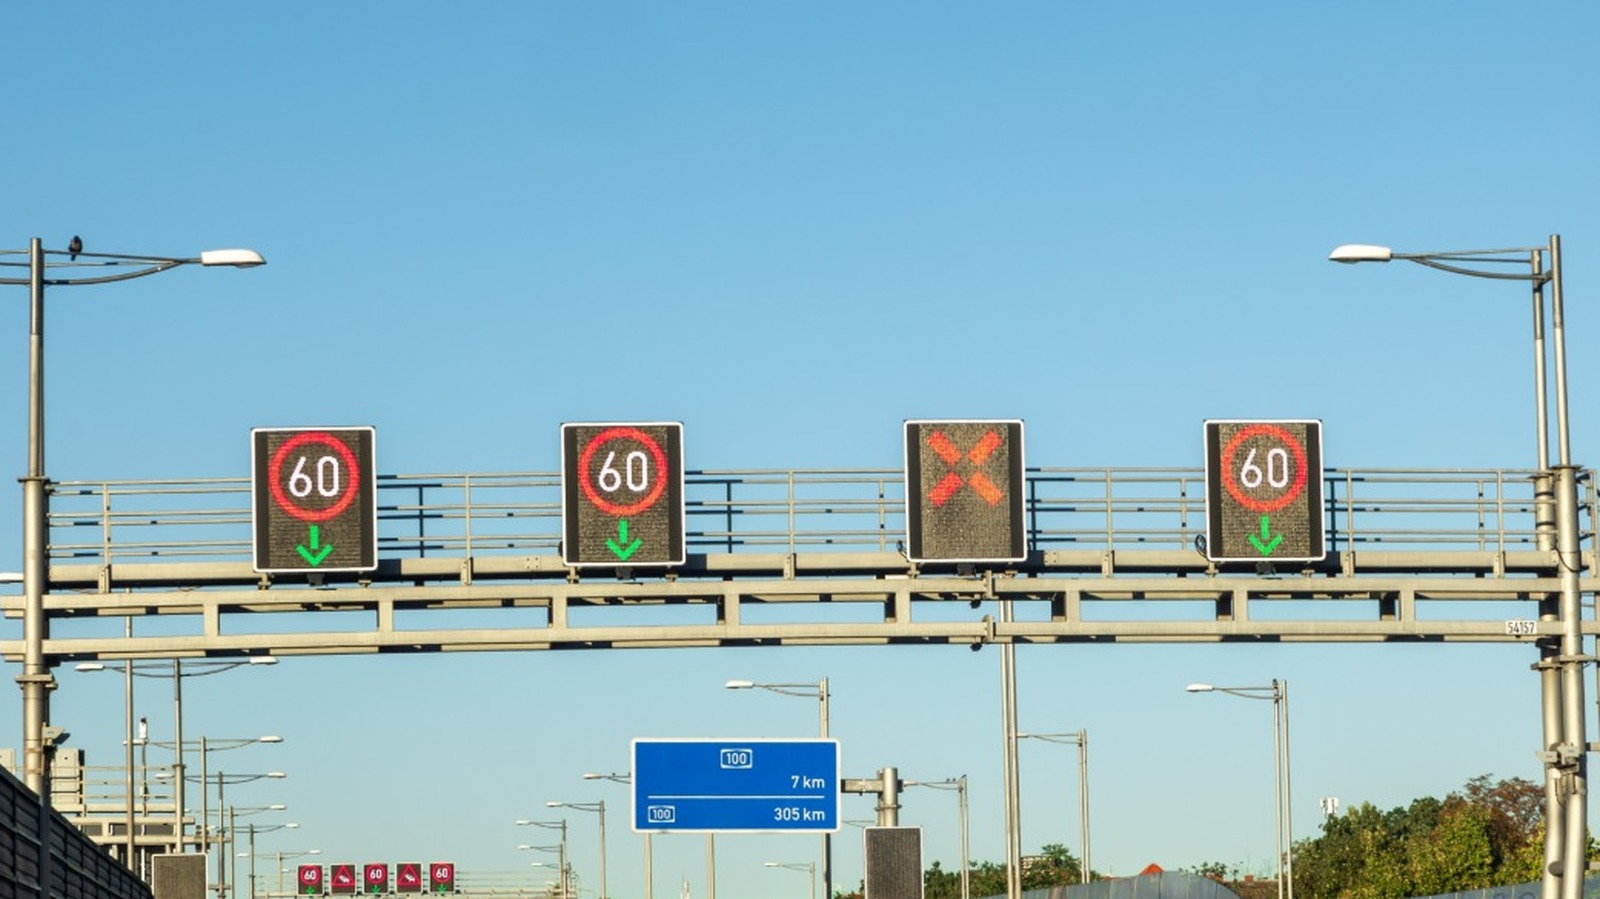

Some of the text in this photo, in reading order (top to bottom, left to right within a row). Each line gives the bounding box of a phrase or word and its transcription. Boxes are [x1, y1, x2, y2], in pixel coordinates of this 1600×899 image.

[598, 451, 649, 493] 60
[1240, 447, 1289, 489] 60
[288, 456, 340, 498] 60
[1507, 621, 1535, 634] 54157
[726, 752, 747, 765] 100
[791, 775, 825, 789] 7 km
[652, 809, 671, 820] 100
[774, 807, 825, 821] 305 km
[303, 869, 317, 881] 60
[369, 868, 382, 880] 60
[435, 867, 449, 879] 60
